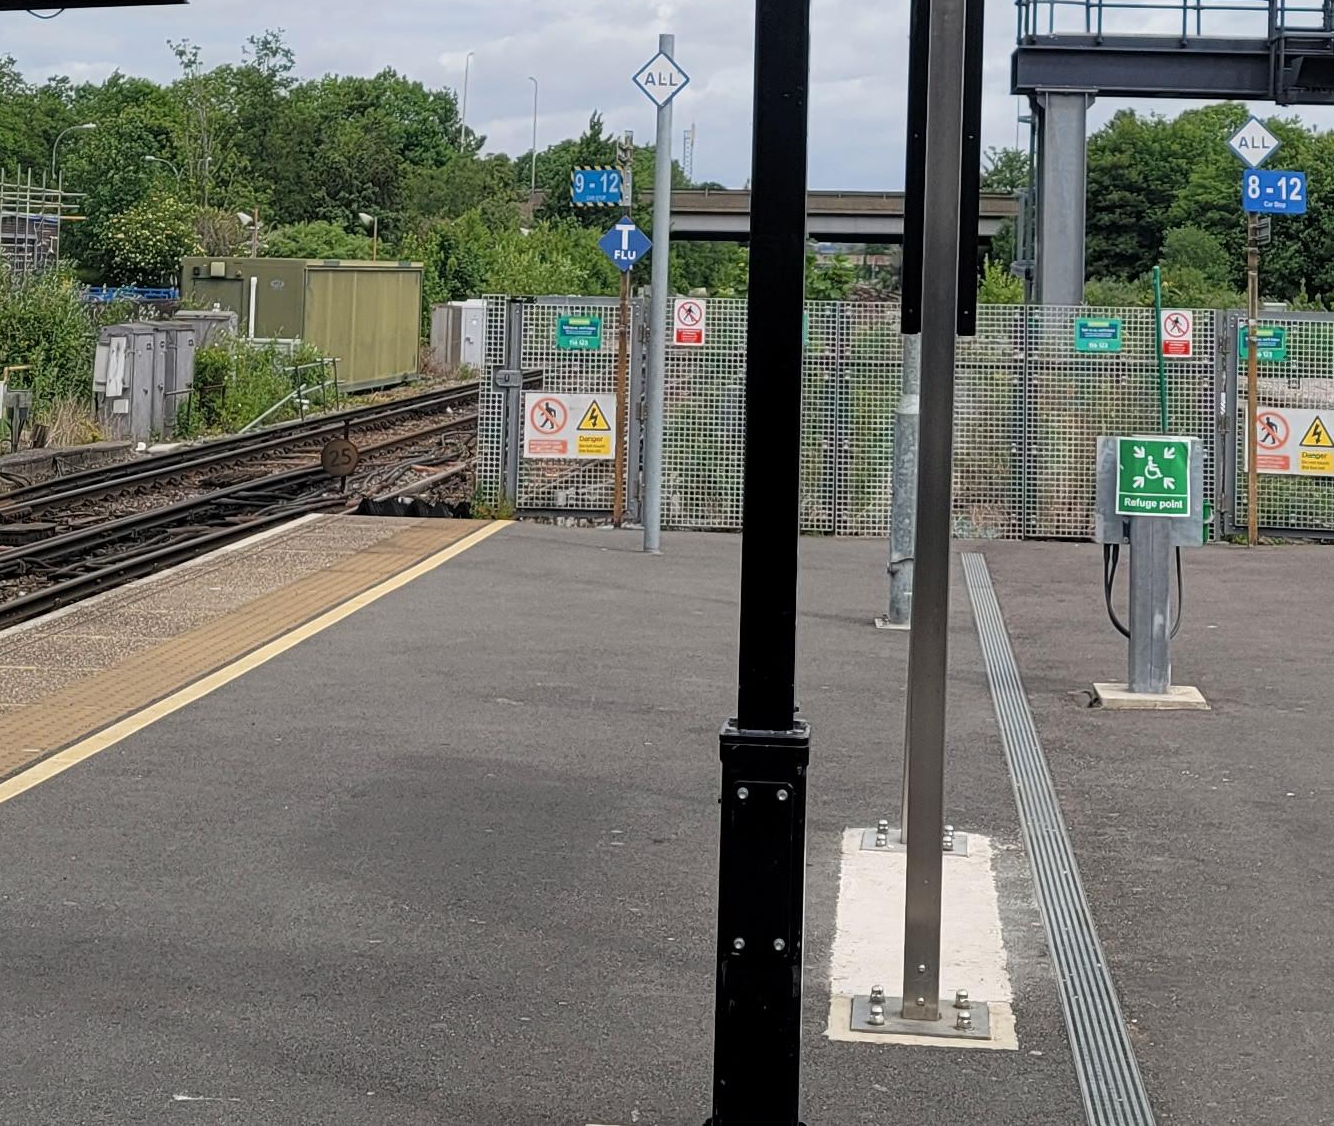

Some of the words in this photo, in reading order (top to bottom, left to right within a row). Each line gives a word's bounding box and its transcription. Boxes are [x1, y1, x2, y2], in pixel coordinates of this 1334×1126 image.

[644, 72, 678, 87] ALL
[1238, 136, 1270, 149] ALL
[575, 173, 585, 193] 9
[600, 173, 619, 193] 12
[1248, 175, 1260, 199] 8
[1277, 177, 1302, 201] 12
[615, 225, 636, 250] T
[614, 250, 636, 260] FLU
[579, 435, 604, 443] Danger
[329, 448, 352, 467] 25
[1124, 497, 1157, 510] Refuge
[1159, 499, 1183, 510] point
